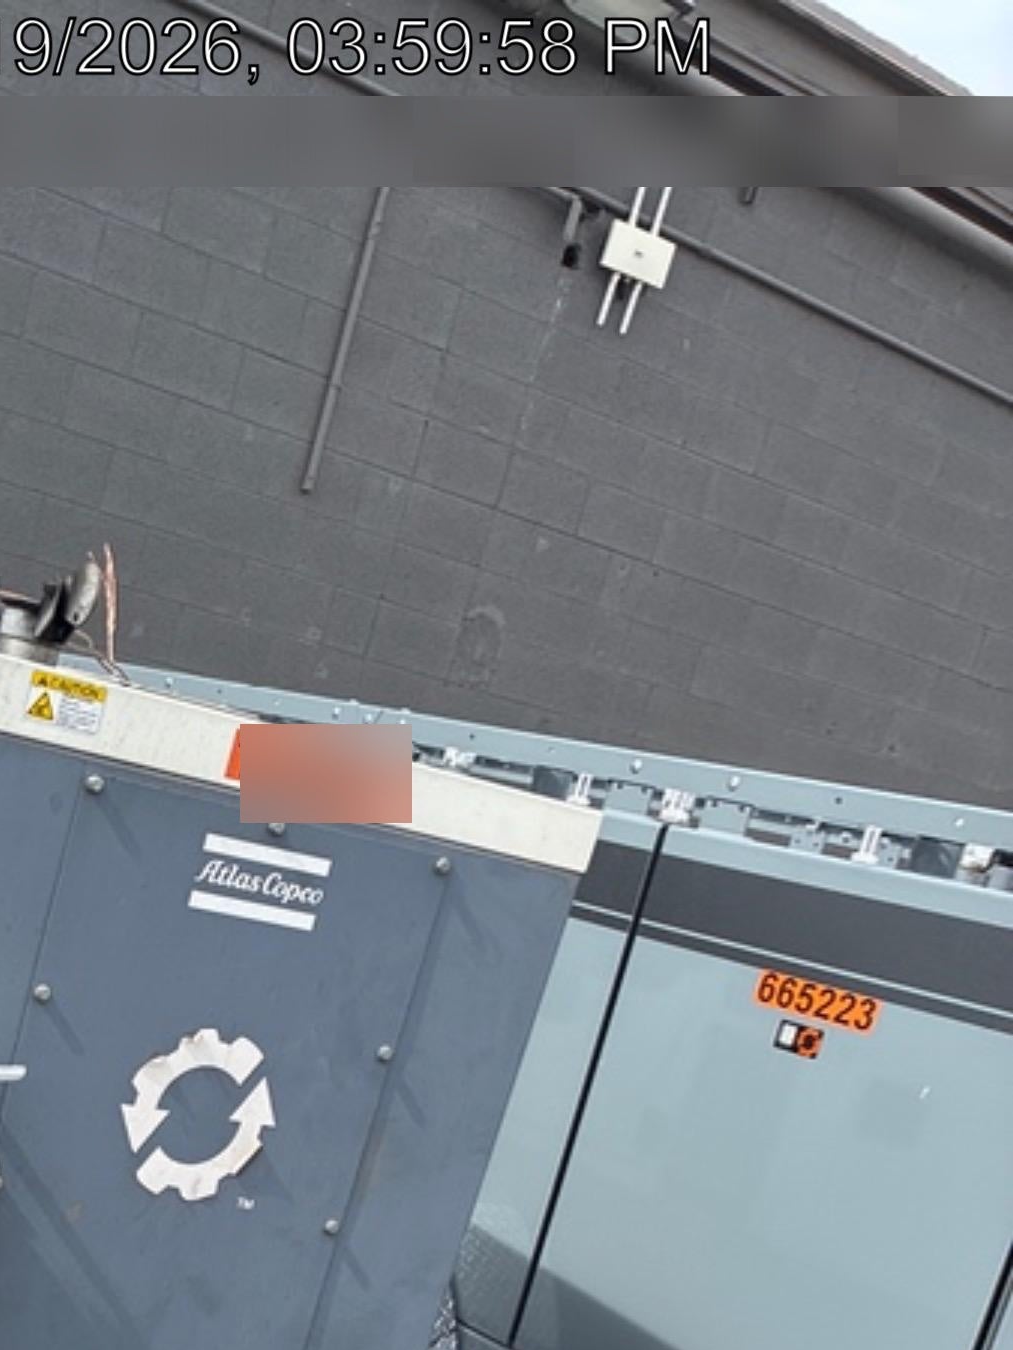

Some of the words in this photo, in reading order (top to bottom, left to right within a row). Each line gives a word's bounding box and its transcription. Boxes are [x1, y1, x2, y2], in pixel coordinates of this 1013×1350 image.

[194, 859, 263, 893] Atlas
[262, 871, 325, 906] Copco
[757, 972, 877, 1031] 665223
